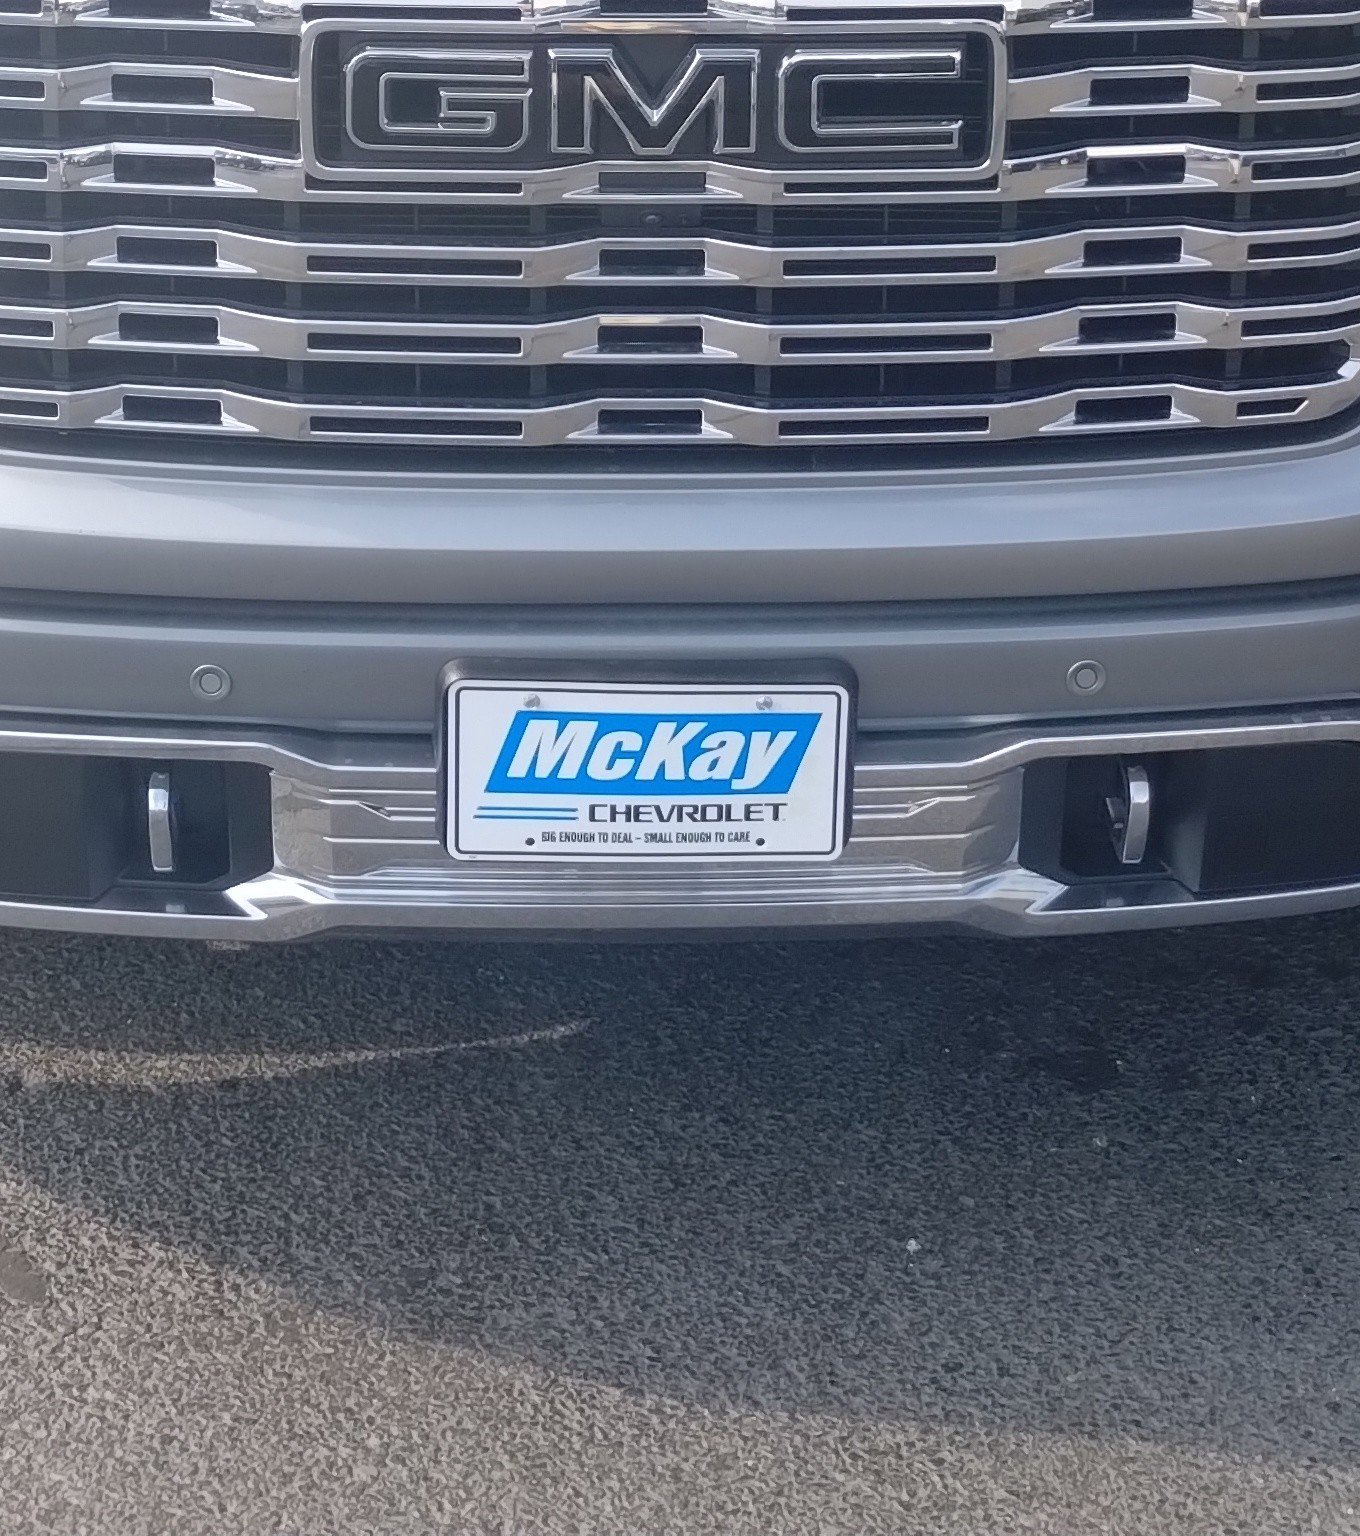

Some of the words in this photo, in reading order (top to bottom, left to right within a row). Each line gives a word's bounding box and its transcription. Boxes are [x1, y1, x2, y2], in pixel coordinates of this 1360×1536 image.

[344, 45, 963, 156] GMC
[506, 719, 798, 791] McKay
[589, 802, 788, 822] CHEVROLET
[559, 831, 596, 843] ENOUGH
[598, 831, 609, 843] TO
[611, 832, 634, 844] DEAL
[643, 832, 674, 843] SMALL
[676, 831, 712, 843] ENOUGH
[714, 831, 725, 843] TO
[727, 831, 751, 843] CARE
